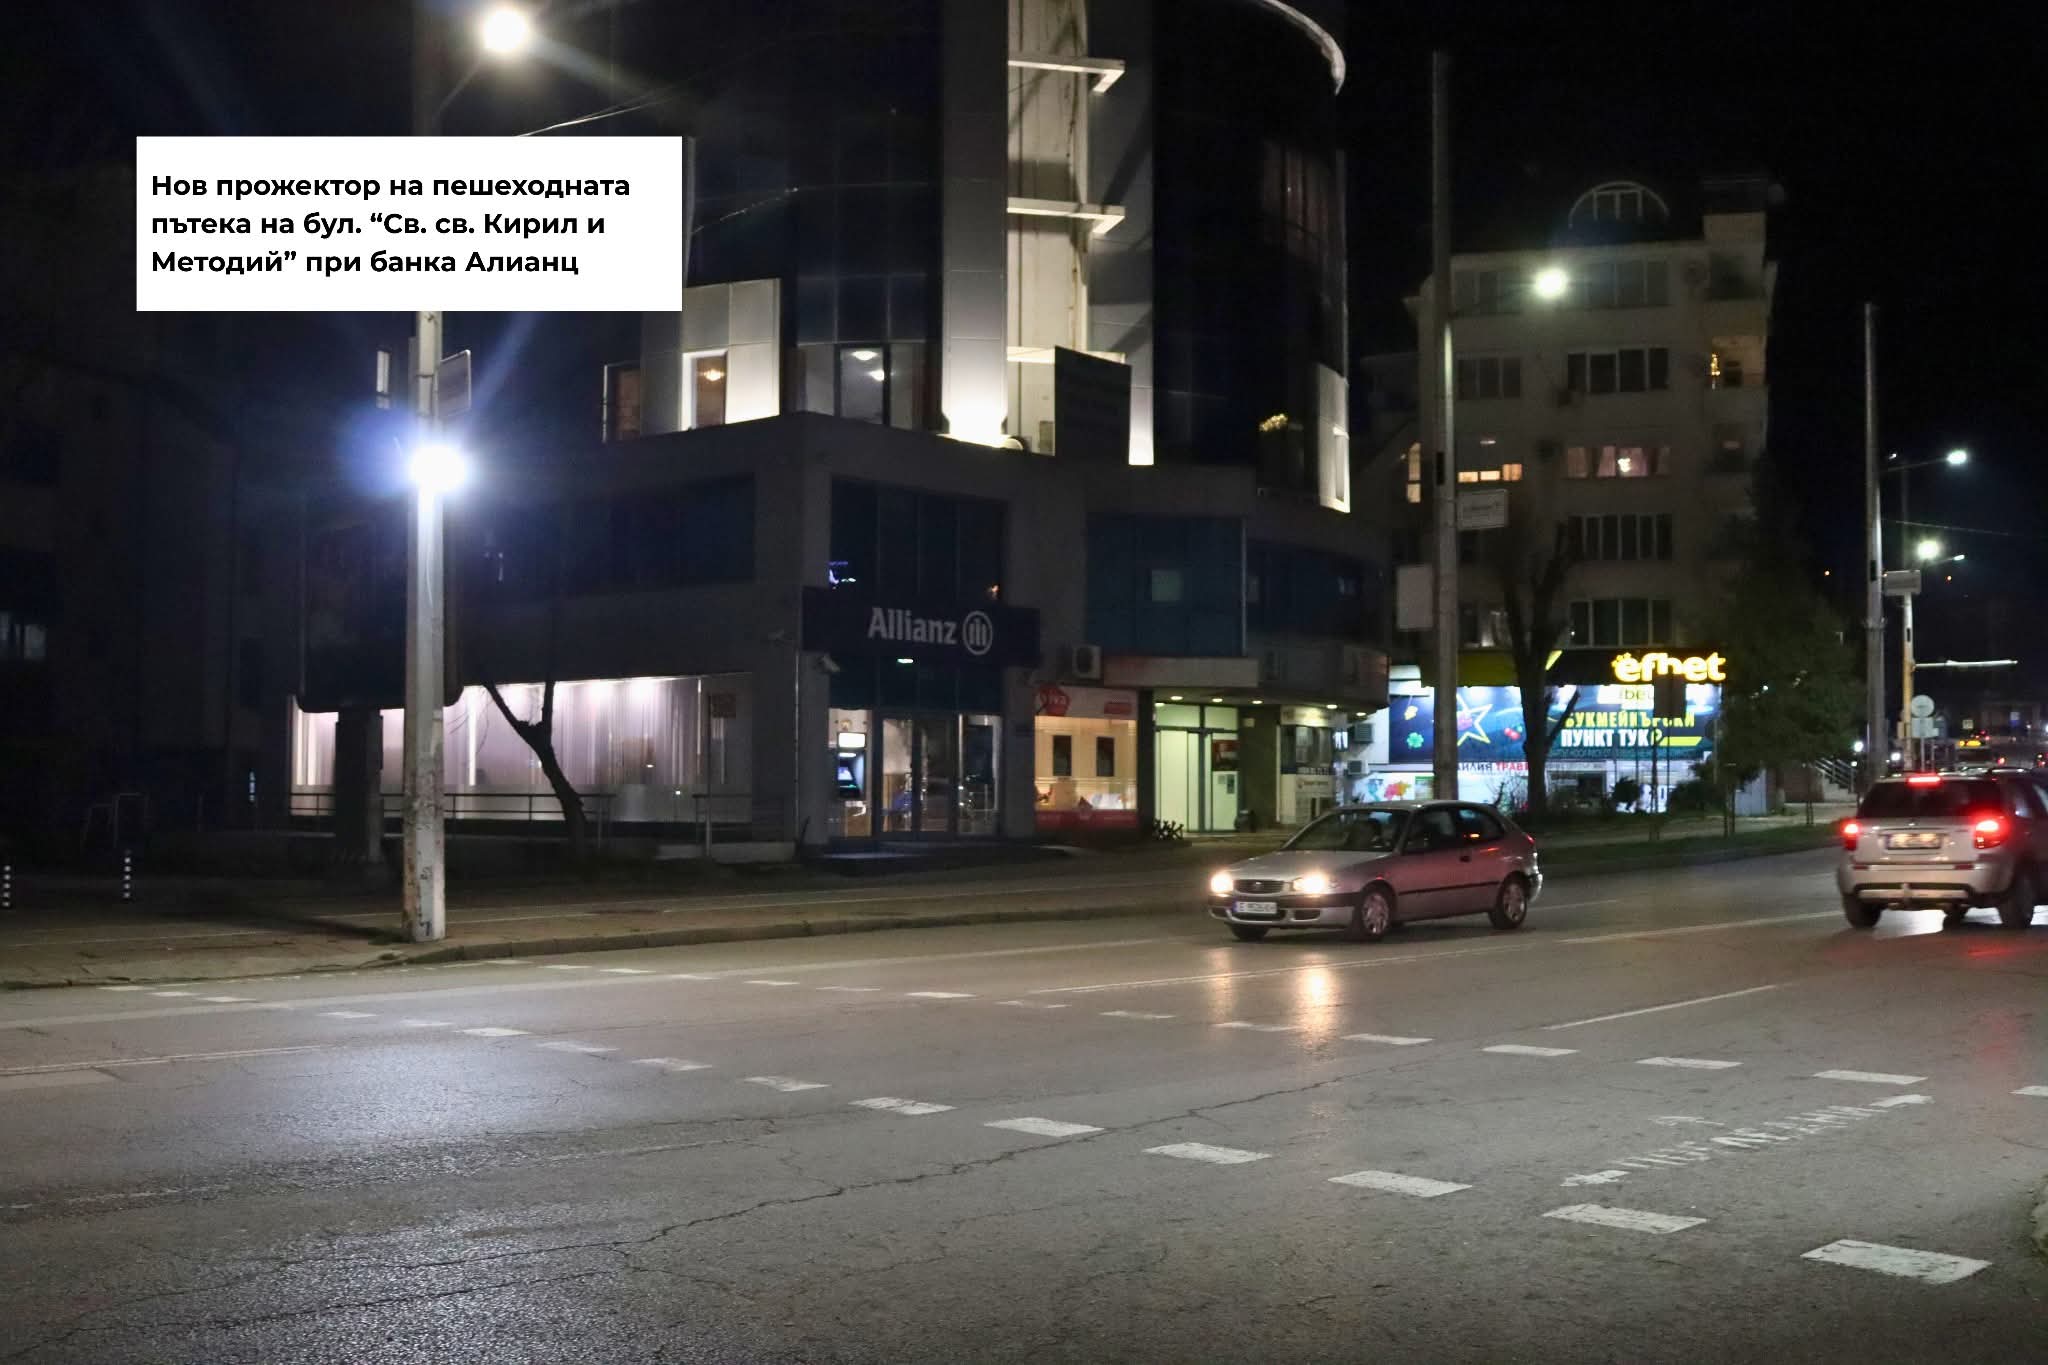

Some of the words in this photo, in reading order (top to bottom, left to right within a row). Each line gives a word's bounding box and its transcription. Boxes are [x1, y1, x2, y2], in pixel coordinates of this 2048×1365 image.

[867, 606, 958, 645] Allianz
[1560, 728, 1615, 747] ПУНКТ
[1617, 728, 1650, 747] ТУК
